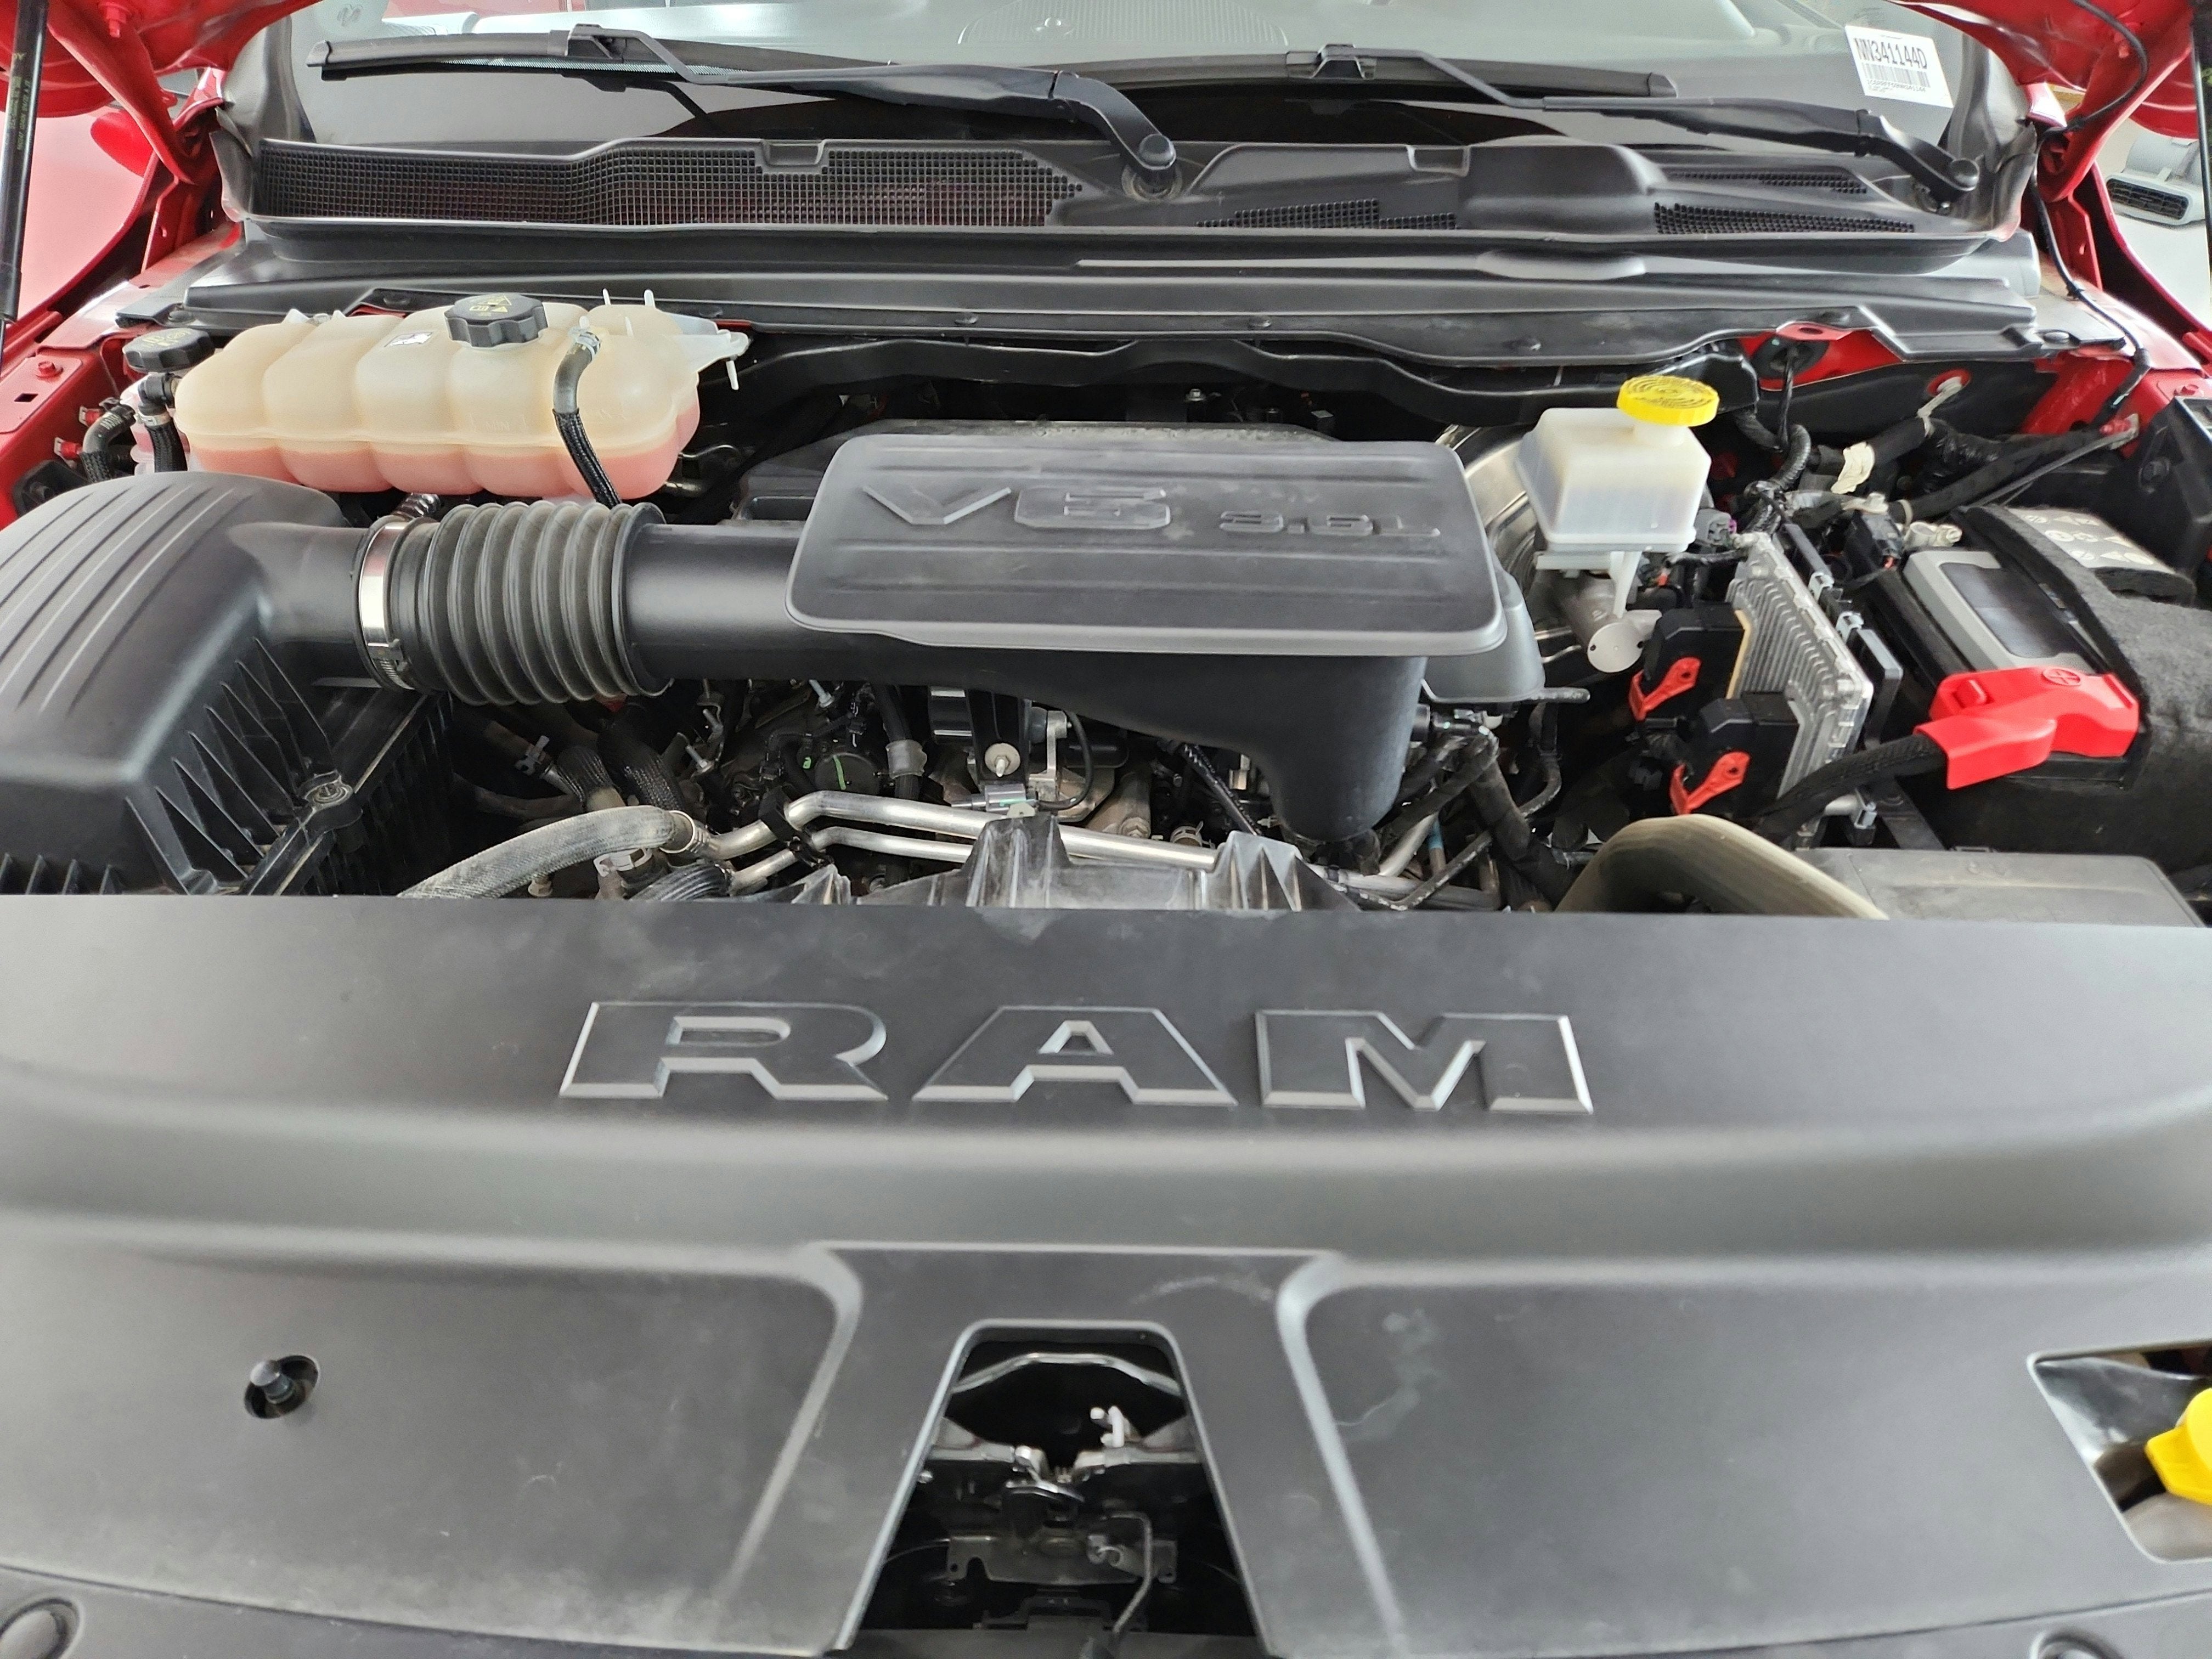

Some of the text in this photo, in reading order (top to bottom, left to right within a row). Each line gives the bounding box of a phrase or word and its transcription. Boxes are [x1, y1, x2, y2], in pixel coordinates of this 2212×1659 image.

[863, 485, 1441, 537] V6 3.6L
[558, 1001, 1594, 1114] RAM
